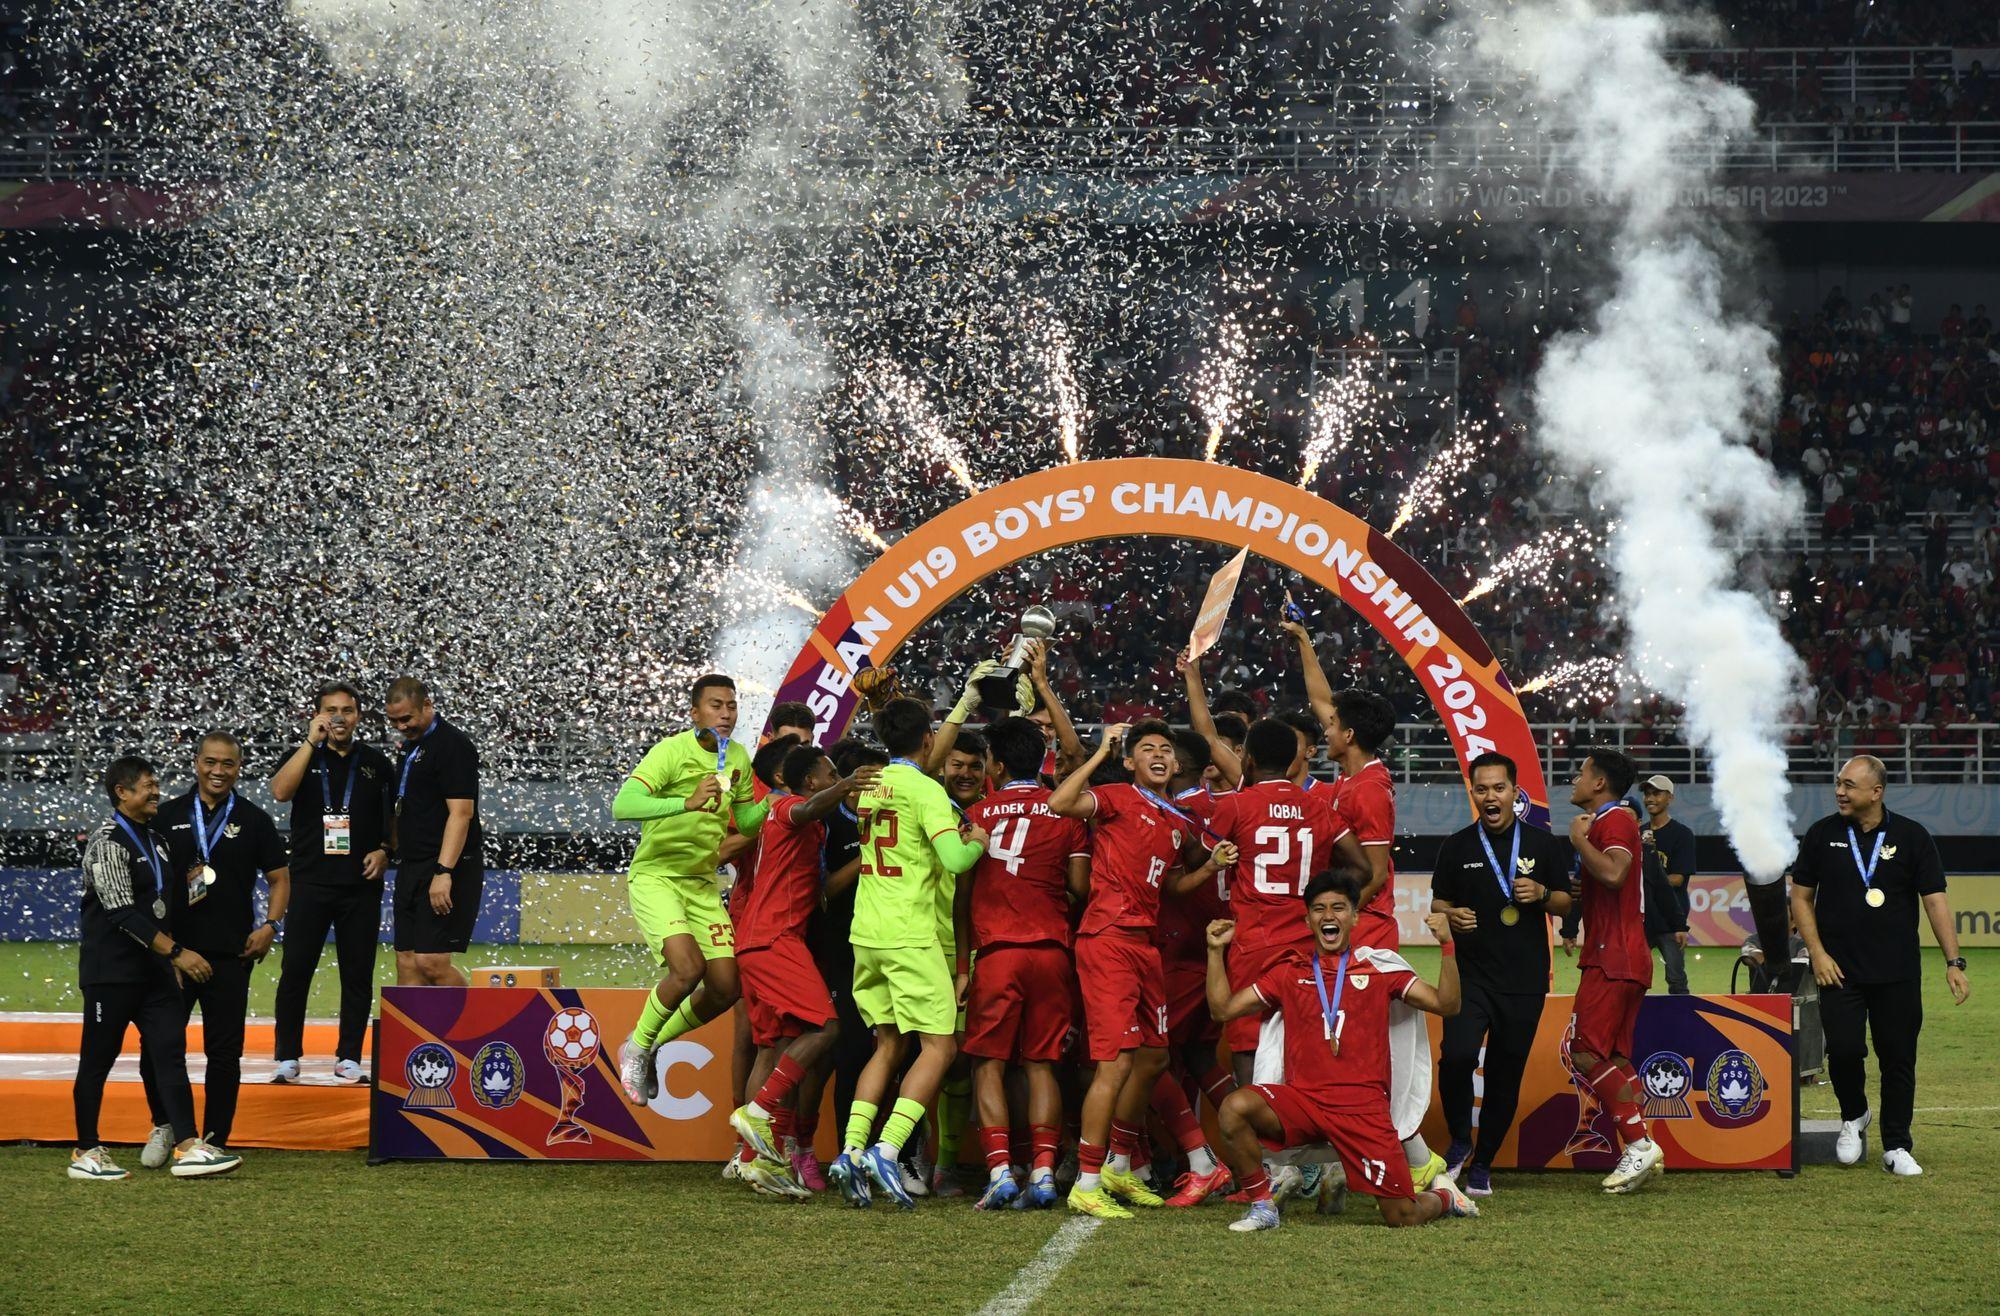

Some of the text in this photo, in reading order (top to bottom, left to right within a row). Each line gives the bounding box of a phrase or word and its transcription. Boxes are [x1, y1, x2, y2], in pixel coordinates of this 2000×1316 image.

[1354, 187, 1411, 207] FIFA
[1478, 187, 1572, 207] WORLD
[884, 546, 957, 608] U19
[1111, 482, 1440, 649] CHAMPIONSHIP
[1427, 653, 1497, 762] 2024
[982, 803, 1025, 818] KADEK
[1269, 803, 1305, 820] IQBAL
[857, 807, 903, 877] 22
[988, 818, 1031, 877] 4
[1146, 855, 1167, 889] 12
[1254, 826, 1313, 896] 21
[1689, 888, 1750, 913] 024
[1321, 1010, 1346, 1041] 17
[485, 1062, 511, 1072] PSSI
[1722, 1070, 1748, 1081] PSSI
[1361, 1157, 1386, 1186] 17
